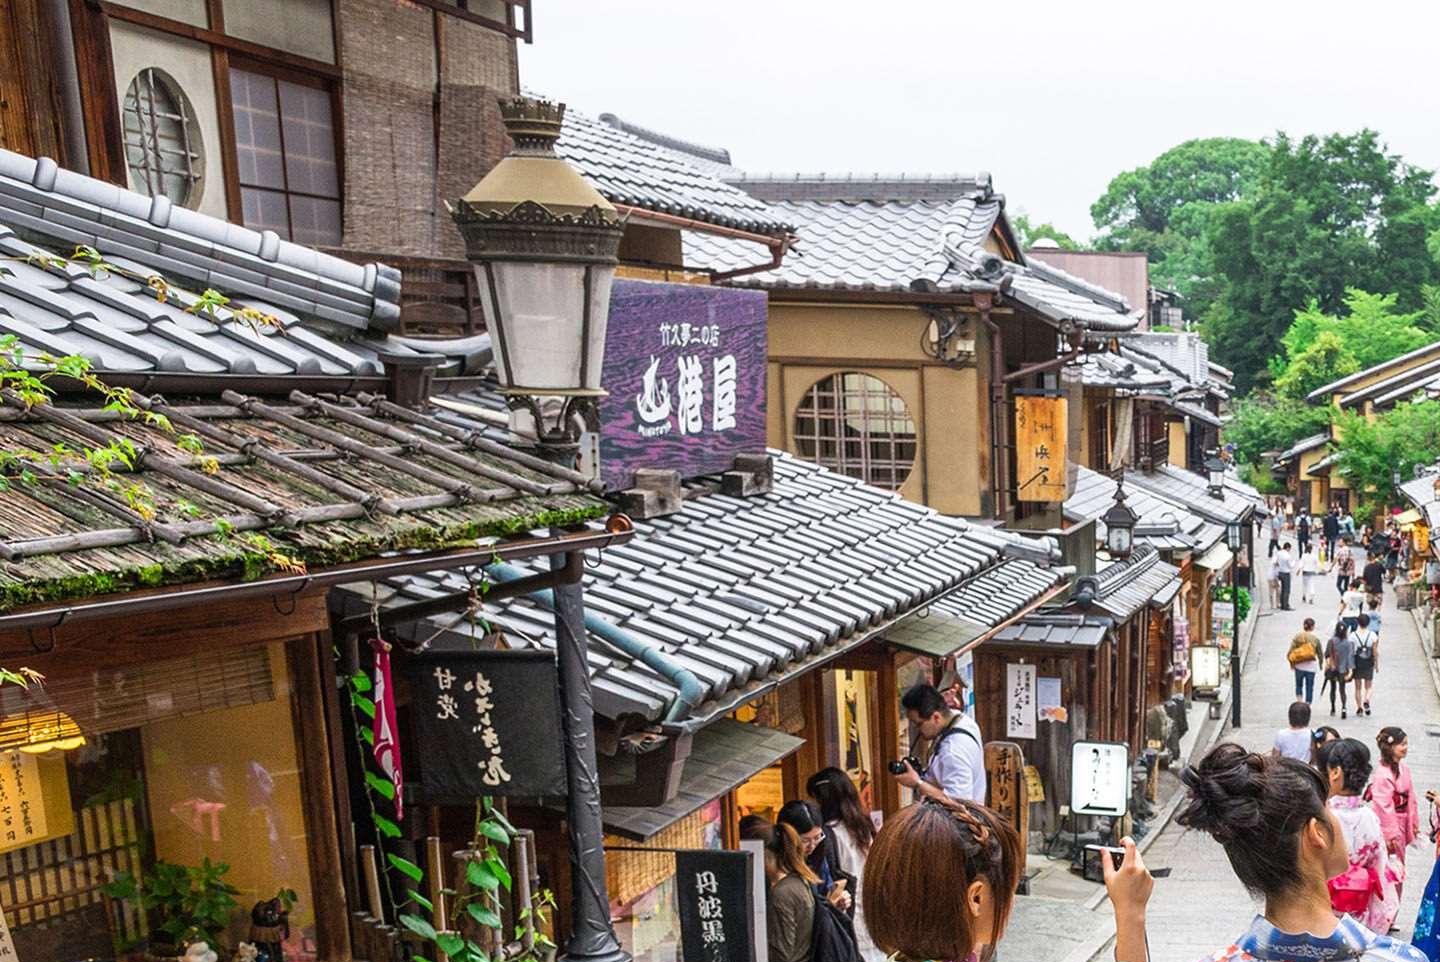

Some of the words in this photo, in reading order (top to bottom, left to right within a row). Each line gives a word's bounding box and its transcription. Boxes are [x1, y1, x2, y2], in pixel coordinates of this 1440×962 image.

[659, 321, 721, 348] 竹久夢二の店
